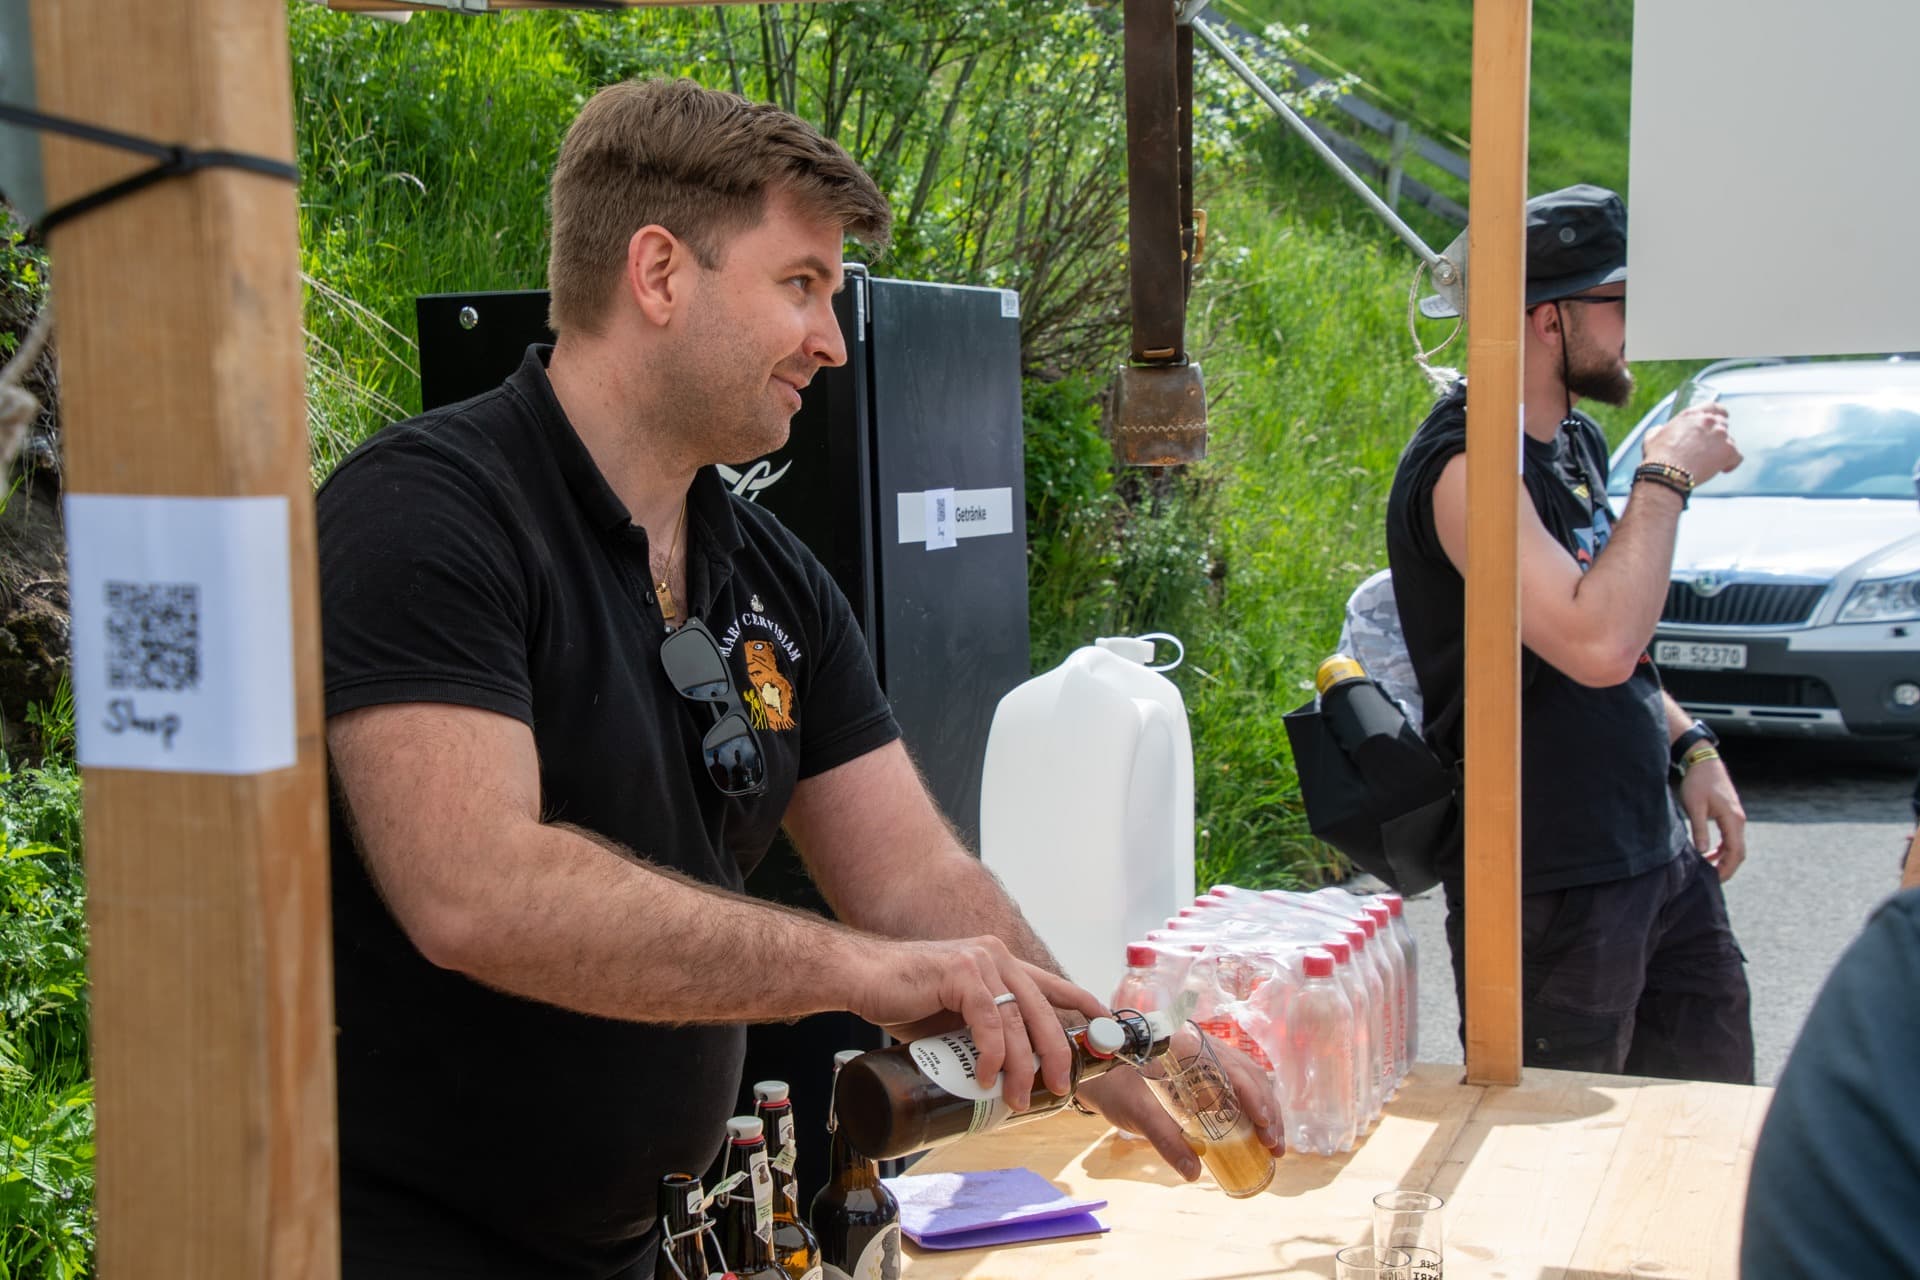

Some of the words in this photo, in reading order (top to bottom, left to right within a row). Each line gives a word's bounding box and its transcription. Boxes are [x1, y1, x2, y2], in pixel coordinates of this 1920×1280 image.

[955, 505, 987, 523] Getränke
[742, 613, 802, 662] CERVISIAM
[1690, 646, 1741, 664] 52370
[941, 1036, 977, 1081] MARMOT
